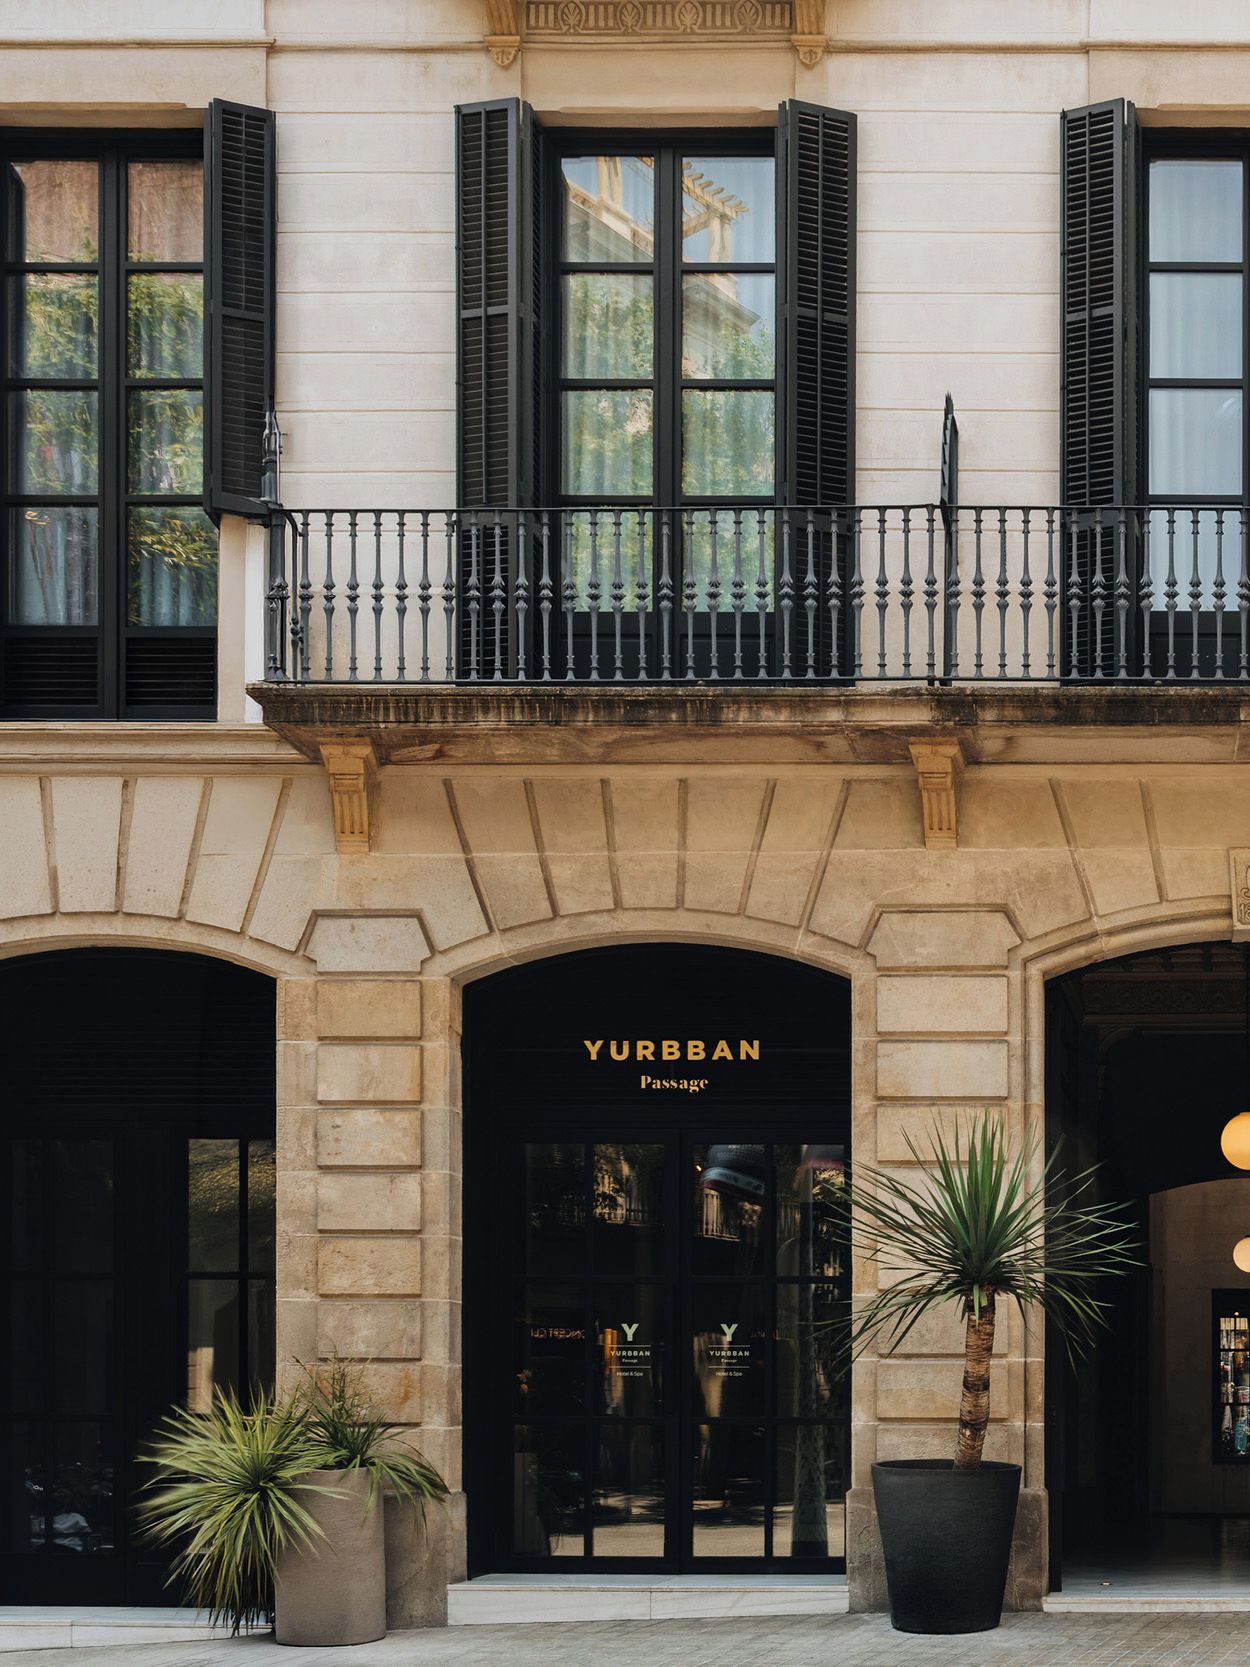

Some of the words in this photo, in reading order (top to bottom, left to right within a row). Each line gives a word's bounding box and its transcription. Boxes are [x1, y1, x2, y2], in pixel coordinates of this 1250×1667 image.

[584, 1040, 760, 1061] YURBBAN
[640, 1075, 709, 1093] Passage
[621, 1323, 639, 1342] Y
[720, 1323, 738, 1342] Y
